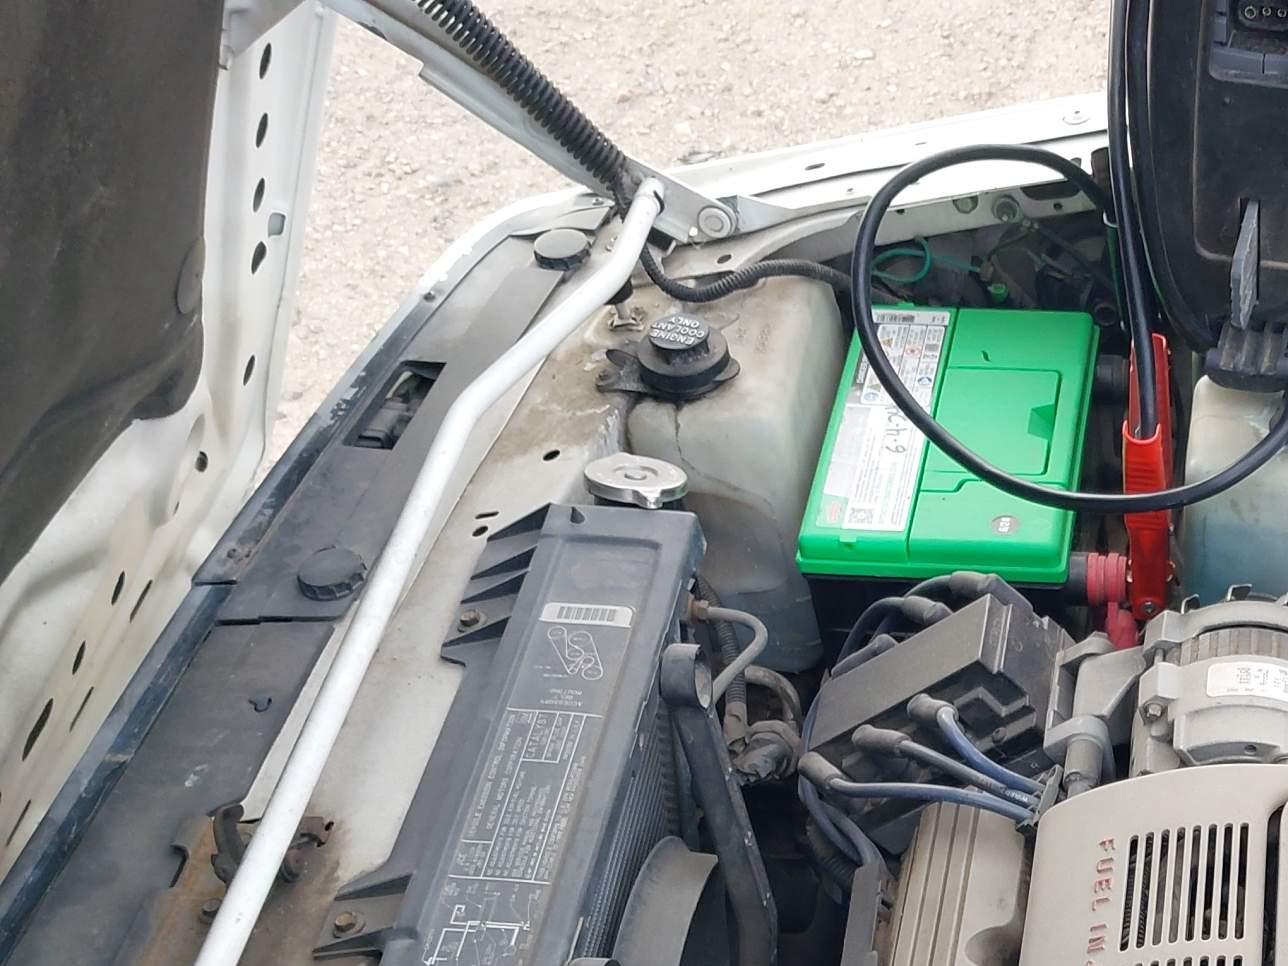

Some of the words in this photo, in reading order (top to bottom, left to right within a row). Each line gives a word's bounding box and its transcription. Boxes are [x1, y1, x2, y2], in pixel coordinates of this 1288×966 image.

[652, 322, 705, 338] COOLANT
[670, 317, 700, 328] ONLY
[650, 329, 695, 344] ENGINE
[1089, 837, 1117, 913] FUEL
